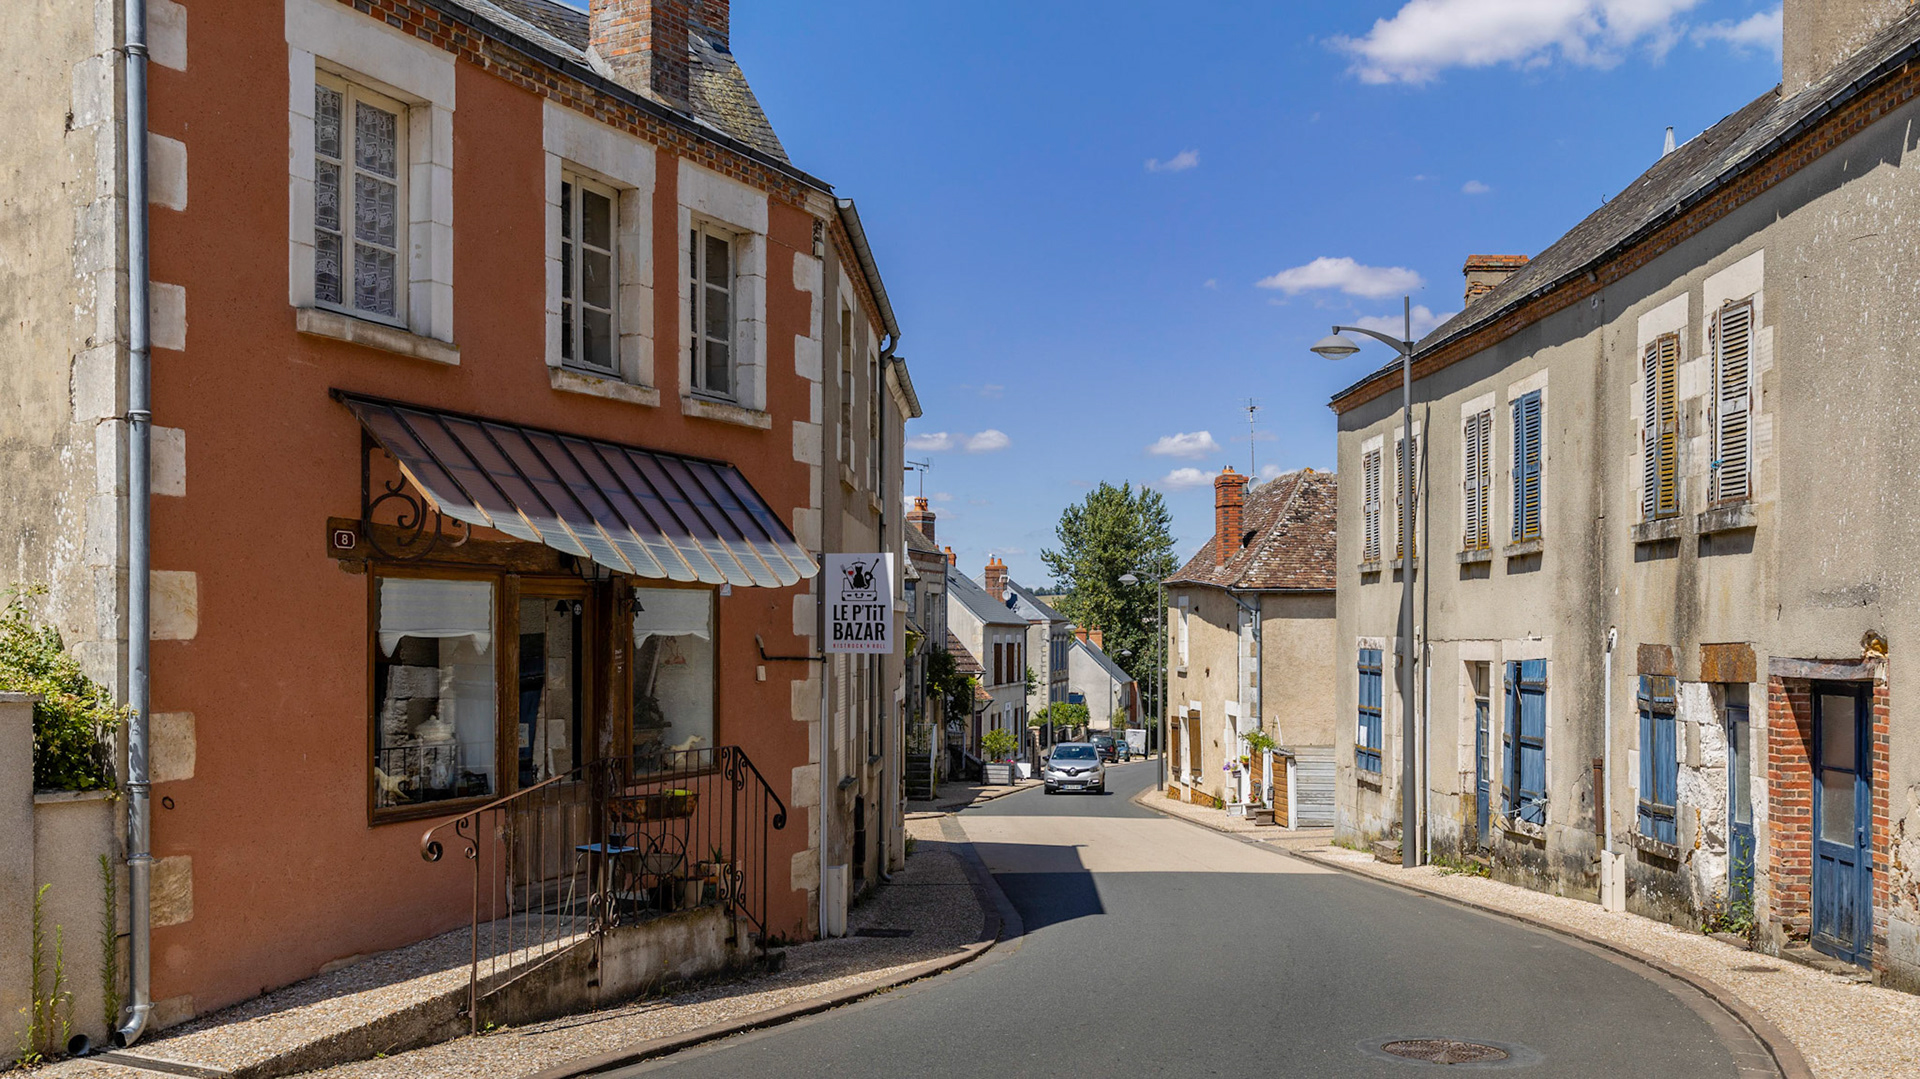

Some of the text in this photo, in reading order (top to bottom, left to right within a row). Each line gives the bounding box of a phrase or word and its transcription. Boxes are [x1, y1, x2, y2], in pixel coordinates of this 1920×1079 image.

[342, 534, 348, 544] 8
[833, 604, 848, 621] LE
[833, 622, 886, 641] BAZAR
